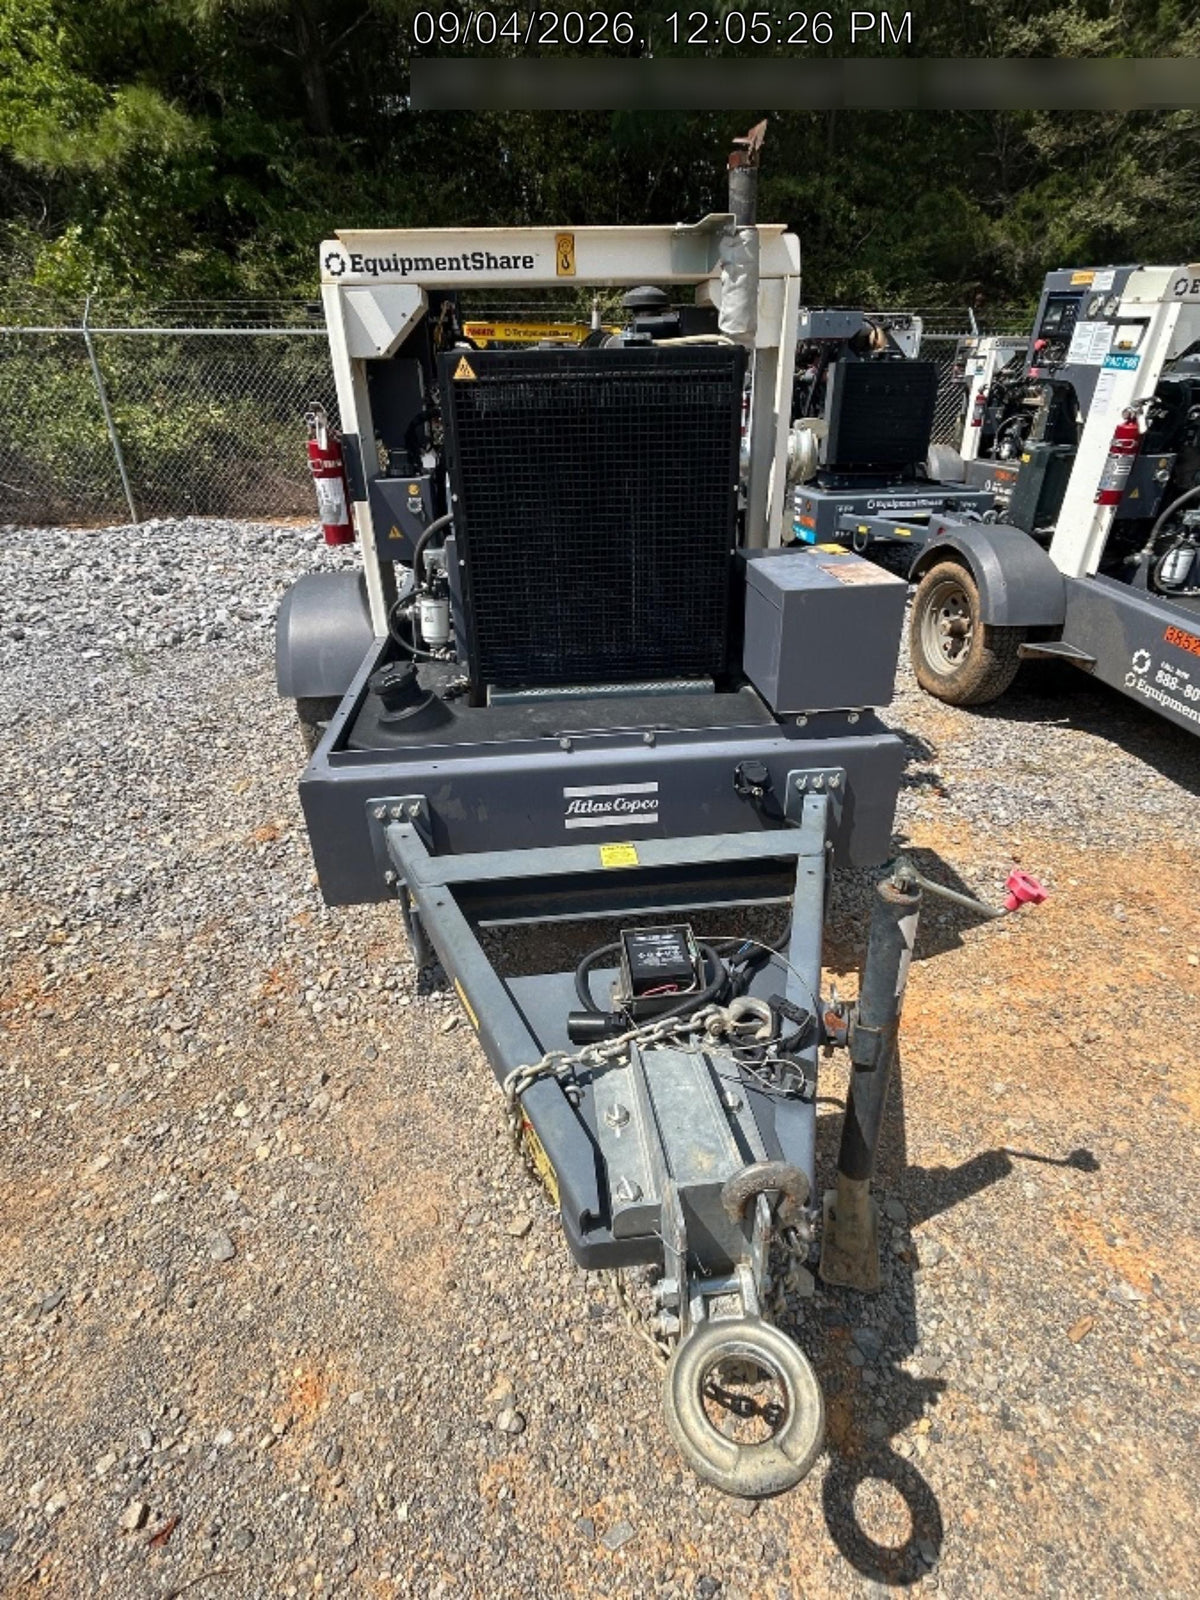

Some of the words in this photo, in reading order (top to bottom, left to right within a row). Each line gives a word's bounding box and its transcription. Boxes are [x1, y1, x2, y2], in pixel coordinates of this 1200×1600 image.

[349, 252, 535, 277] EquipmentShare
[565, 799, 612, 815] Atlas
[613, 797, 659, 813] Copco
